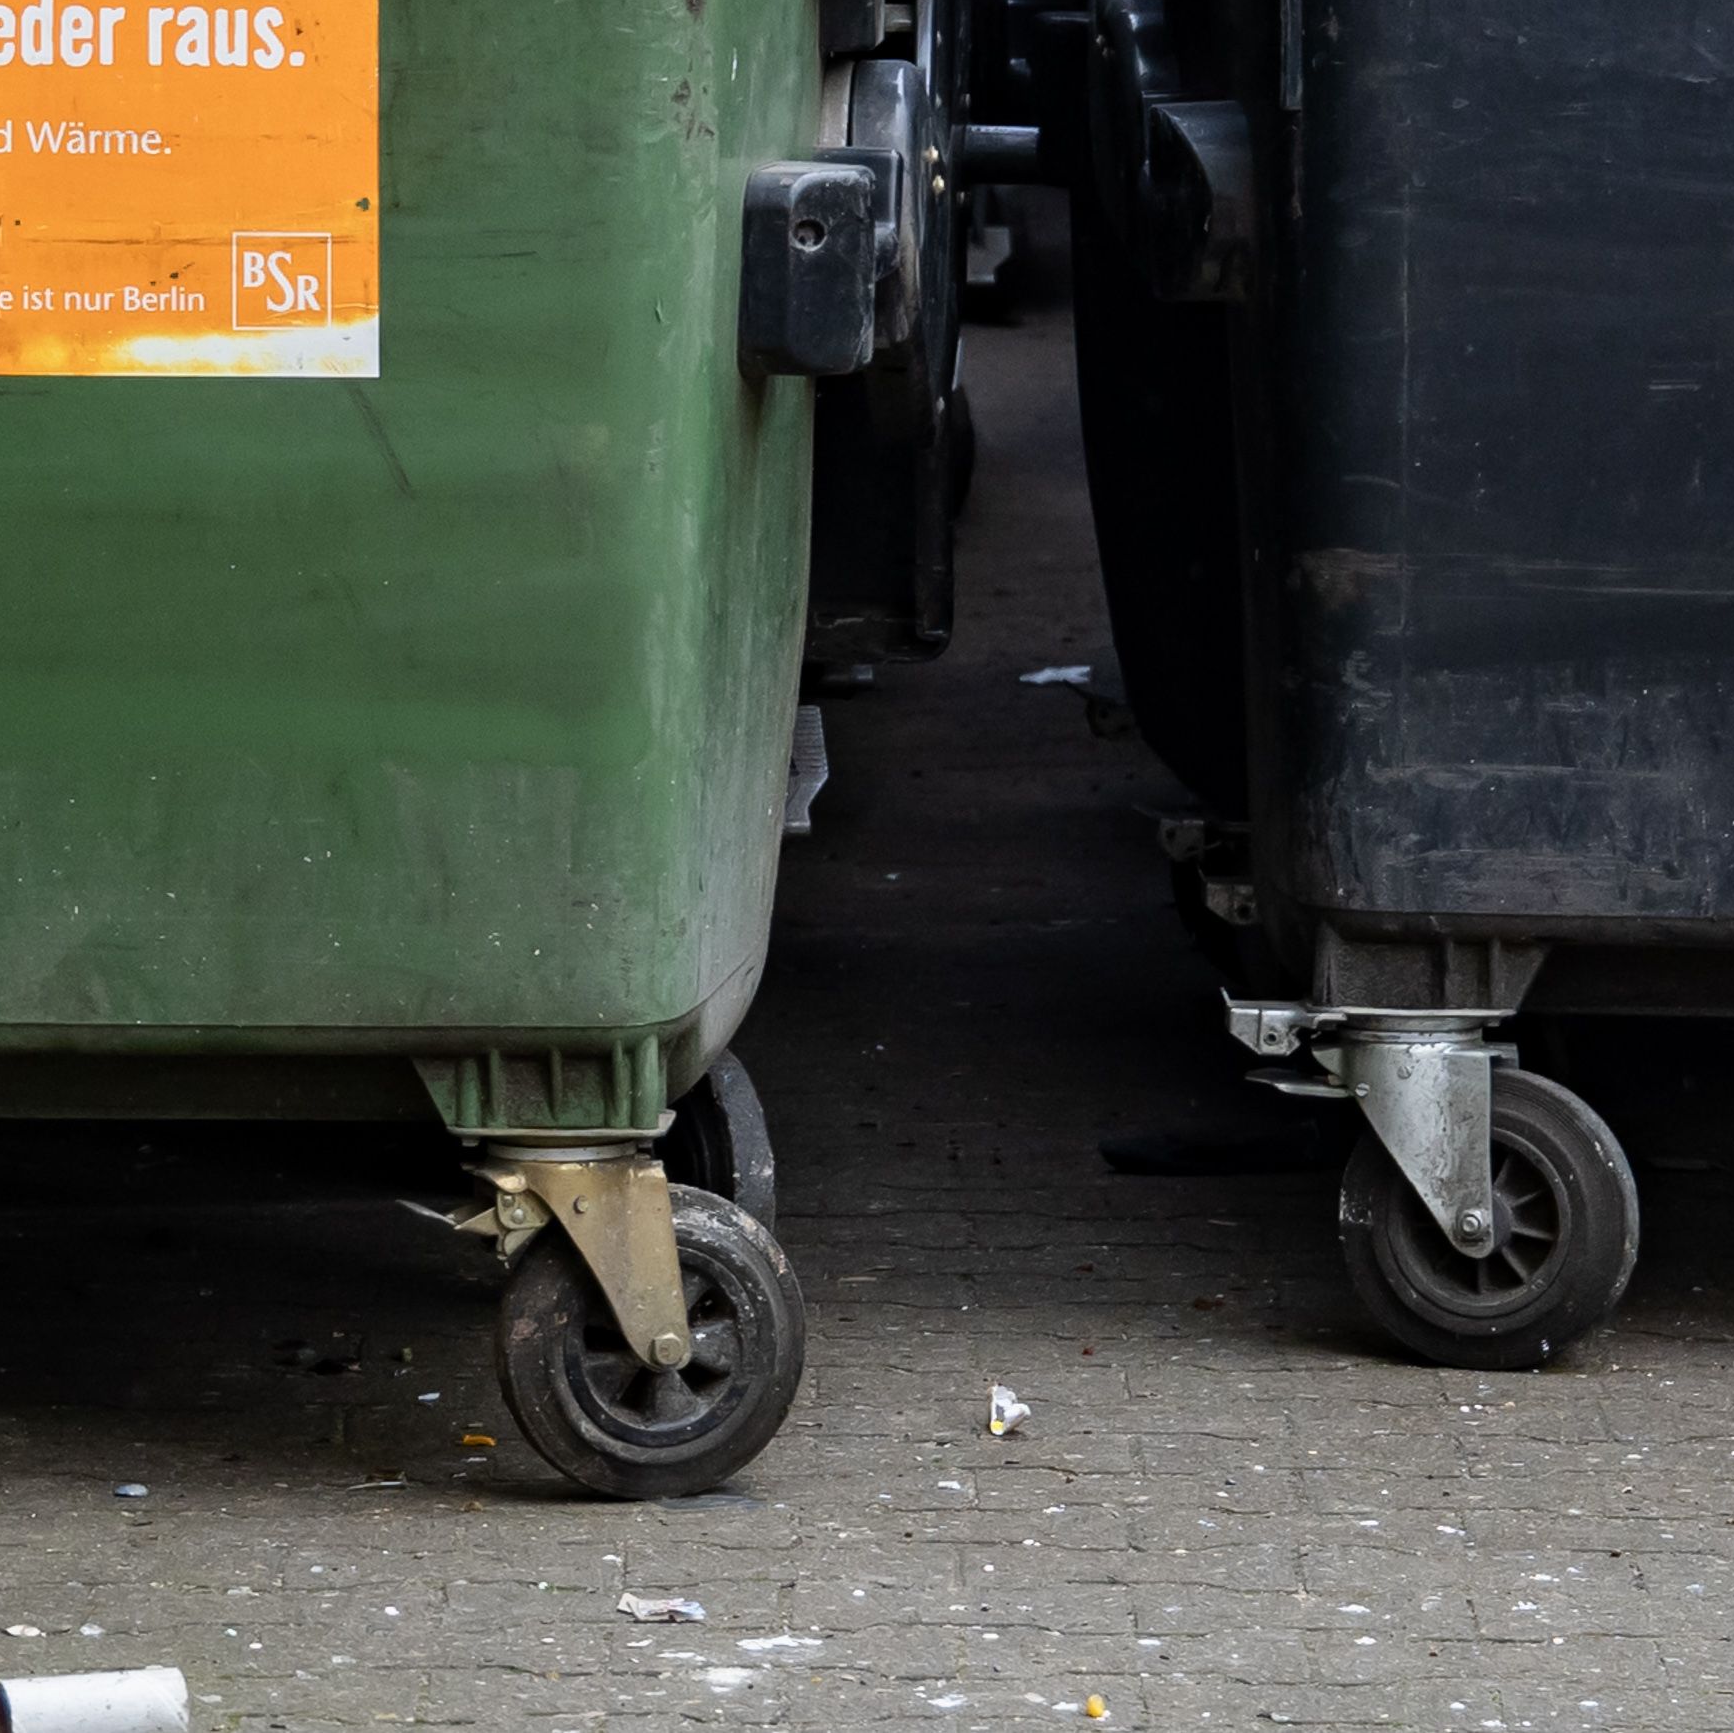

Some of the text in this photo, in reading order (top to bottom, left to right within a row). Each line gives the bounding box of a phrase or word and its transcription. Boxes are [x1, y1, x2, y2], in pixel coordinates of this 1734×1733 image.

[147, 6, 307, 70] raus.
[26, 120, 172, 156] Wärme.
[23, 286, 54, 311] ist
[64, 291, 114, 312] nur
[123, 285, 205, 313] Berlin
[243, 251, 321, 314] BSR
